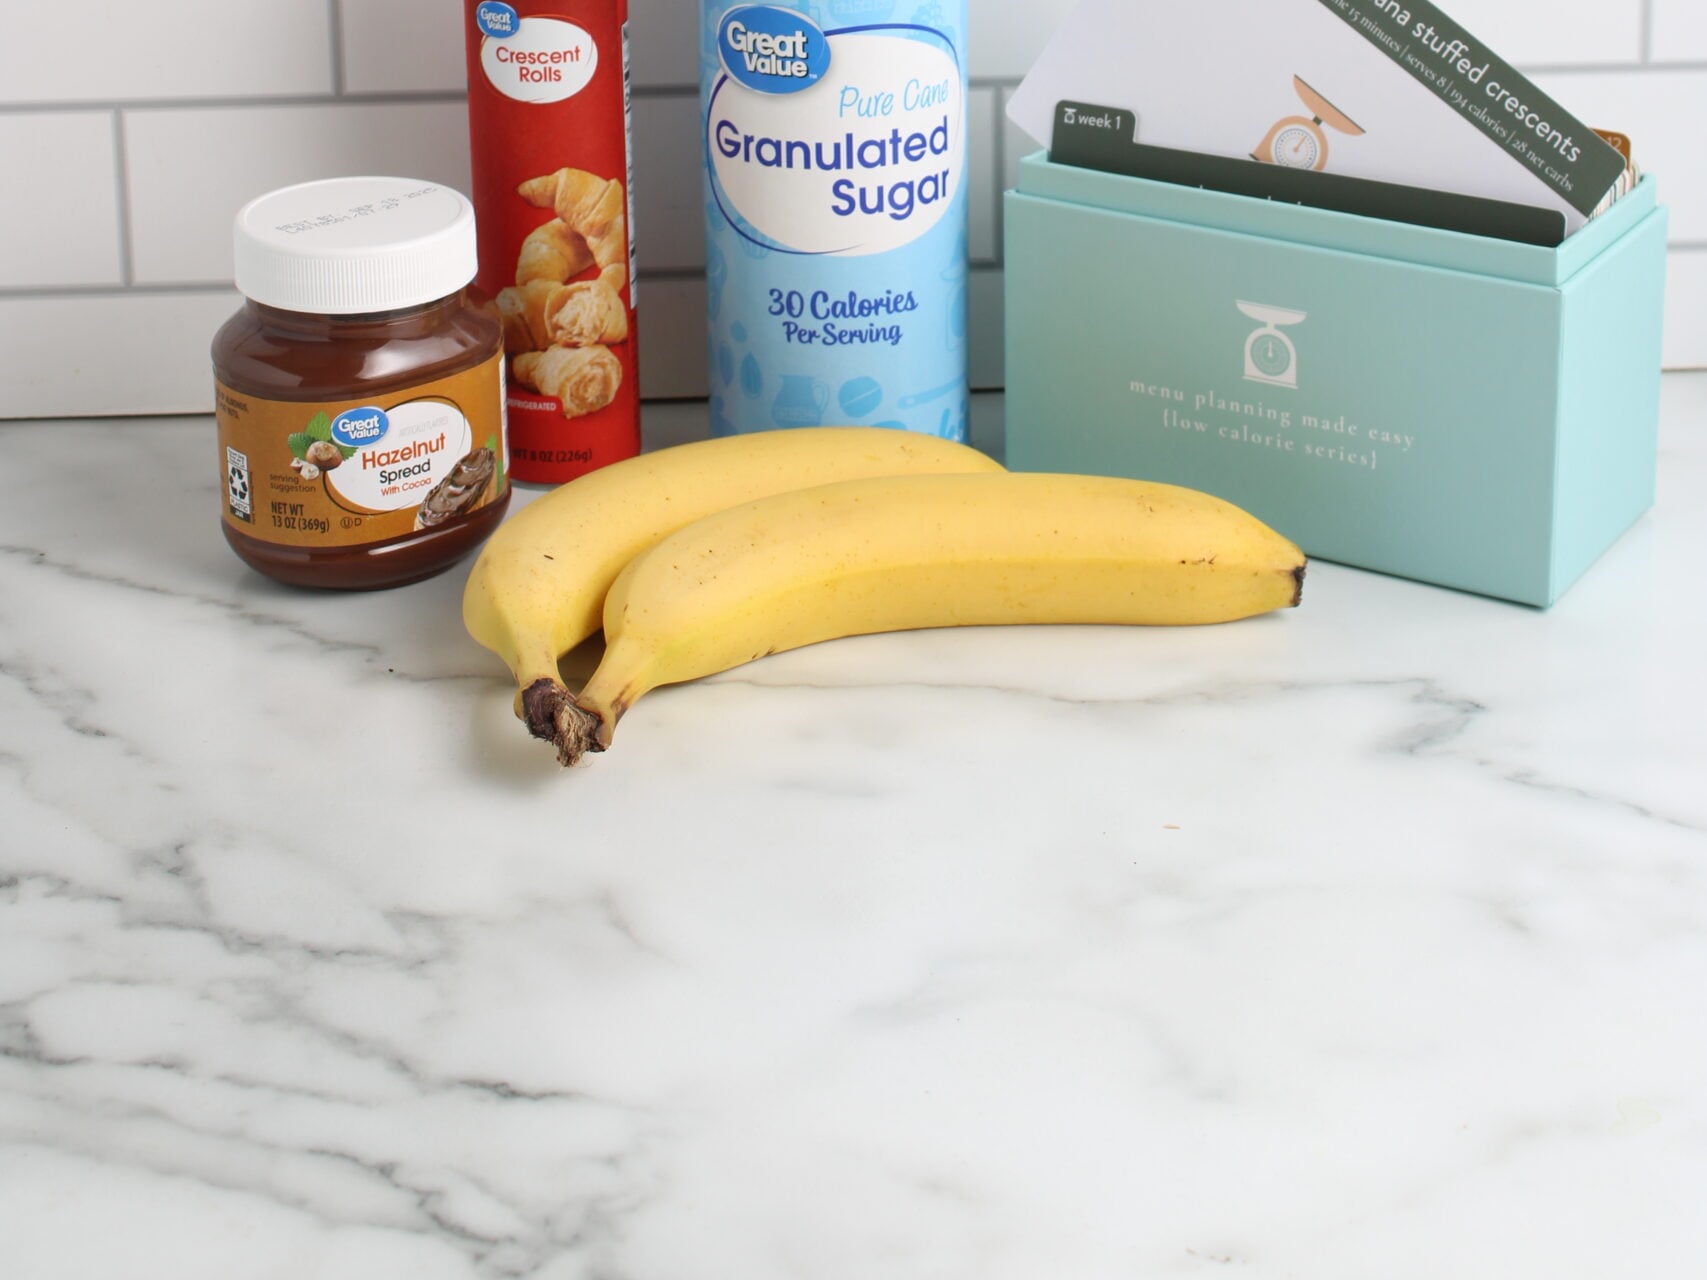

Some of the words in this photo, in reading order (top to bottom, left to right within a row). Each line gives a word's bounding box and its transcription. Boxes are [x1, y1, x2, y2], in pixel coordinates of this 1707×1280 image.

[480, 7, 511, 24] Great
[487, 19, 512, 32] Value
[727, 20, 808, 59] Great
[496, 45, 581, 65] Crescent
[743, 51, 808, 78] Value
[519, 65, 563, 83] Rolls
[839, 84, 894, 117] Pure
[903, 78, 949, 110] Cane
[1347, 7, 1361, 22] 15
[1360, 14, 1403, 52] minutes
[1405, 53, 1438, 82] serves
[1436, 72, 1447, 87] 8
[1450, 89, 1469, 108] 194
[1468, 103, 1509, 139] calories
[1511, 138, 1528, 155] 28
[1526, 149, 1546, 169] net
[1544, 165, 1575, 193] carbs
[1411, 22, 1490, 84] stuffed
[1485, 81, 1581, 163] crescents
[1078, 112, 1112, 129] week
[1114, 115, 1122, 130] 1
[715, 115, 949, 170] Granulated
[831, 168, 949, 221] Sugar
[768, 287, 804, 318] 30
[811, 288, 919, 320] Calories
[782, 321, 822, 345] Per
[822, 321, 903, 347] Serving
[338, 415, 380, 433] Great
[1129, 378, 1185, 402] menu
[1194, 390, 1292, 427] planning
[1302, 413, 1358, 436] made
[1368, 429, 1415, 452] easy
[349, 428, 380, 440] Value
[1218, 425, 1295, 452] calorie
[361, 432, 446, 470] Hazelnut
[539, 450, 553, 462] OZ
[556, 448, 593, 463] (226g)
[269, 474, 299, 485] serving
[379, 458, 431, 485] Spread
[270, 482, 317, 493] suggestion
[380, 484, 401, 497] With
[402, 477, 432, 492] Cocoa
[271, 502, 289, 516] NET
[290, 504, 305, 517] WT
[272, 515, 284, 528] 13
[284, 517, 297, 530] OZ
[298, 518, 330, 534] (369g)
